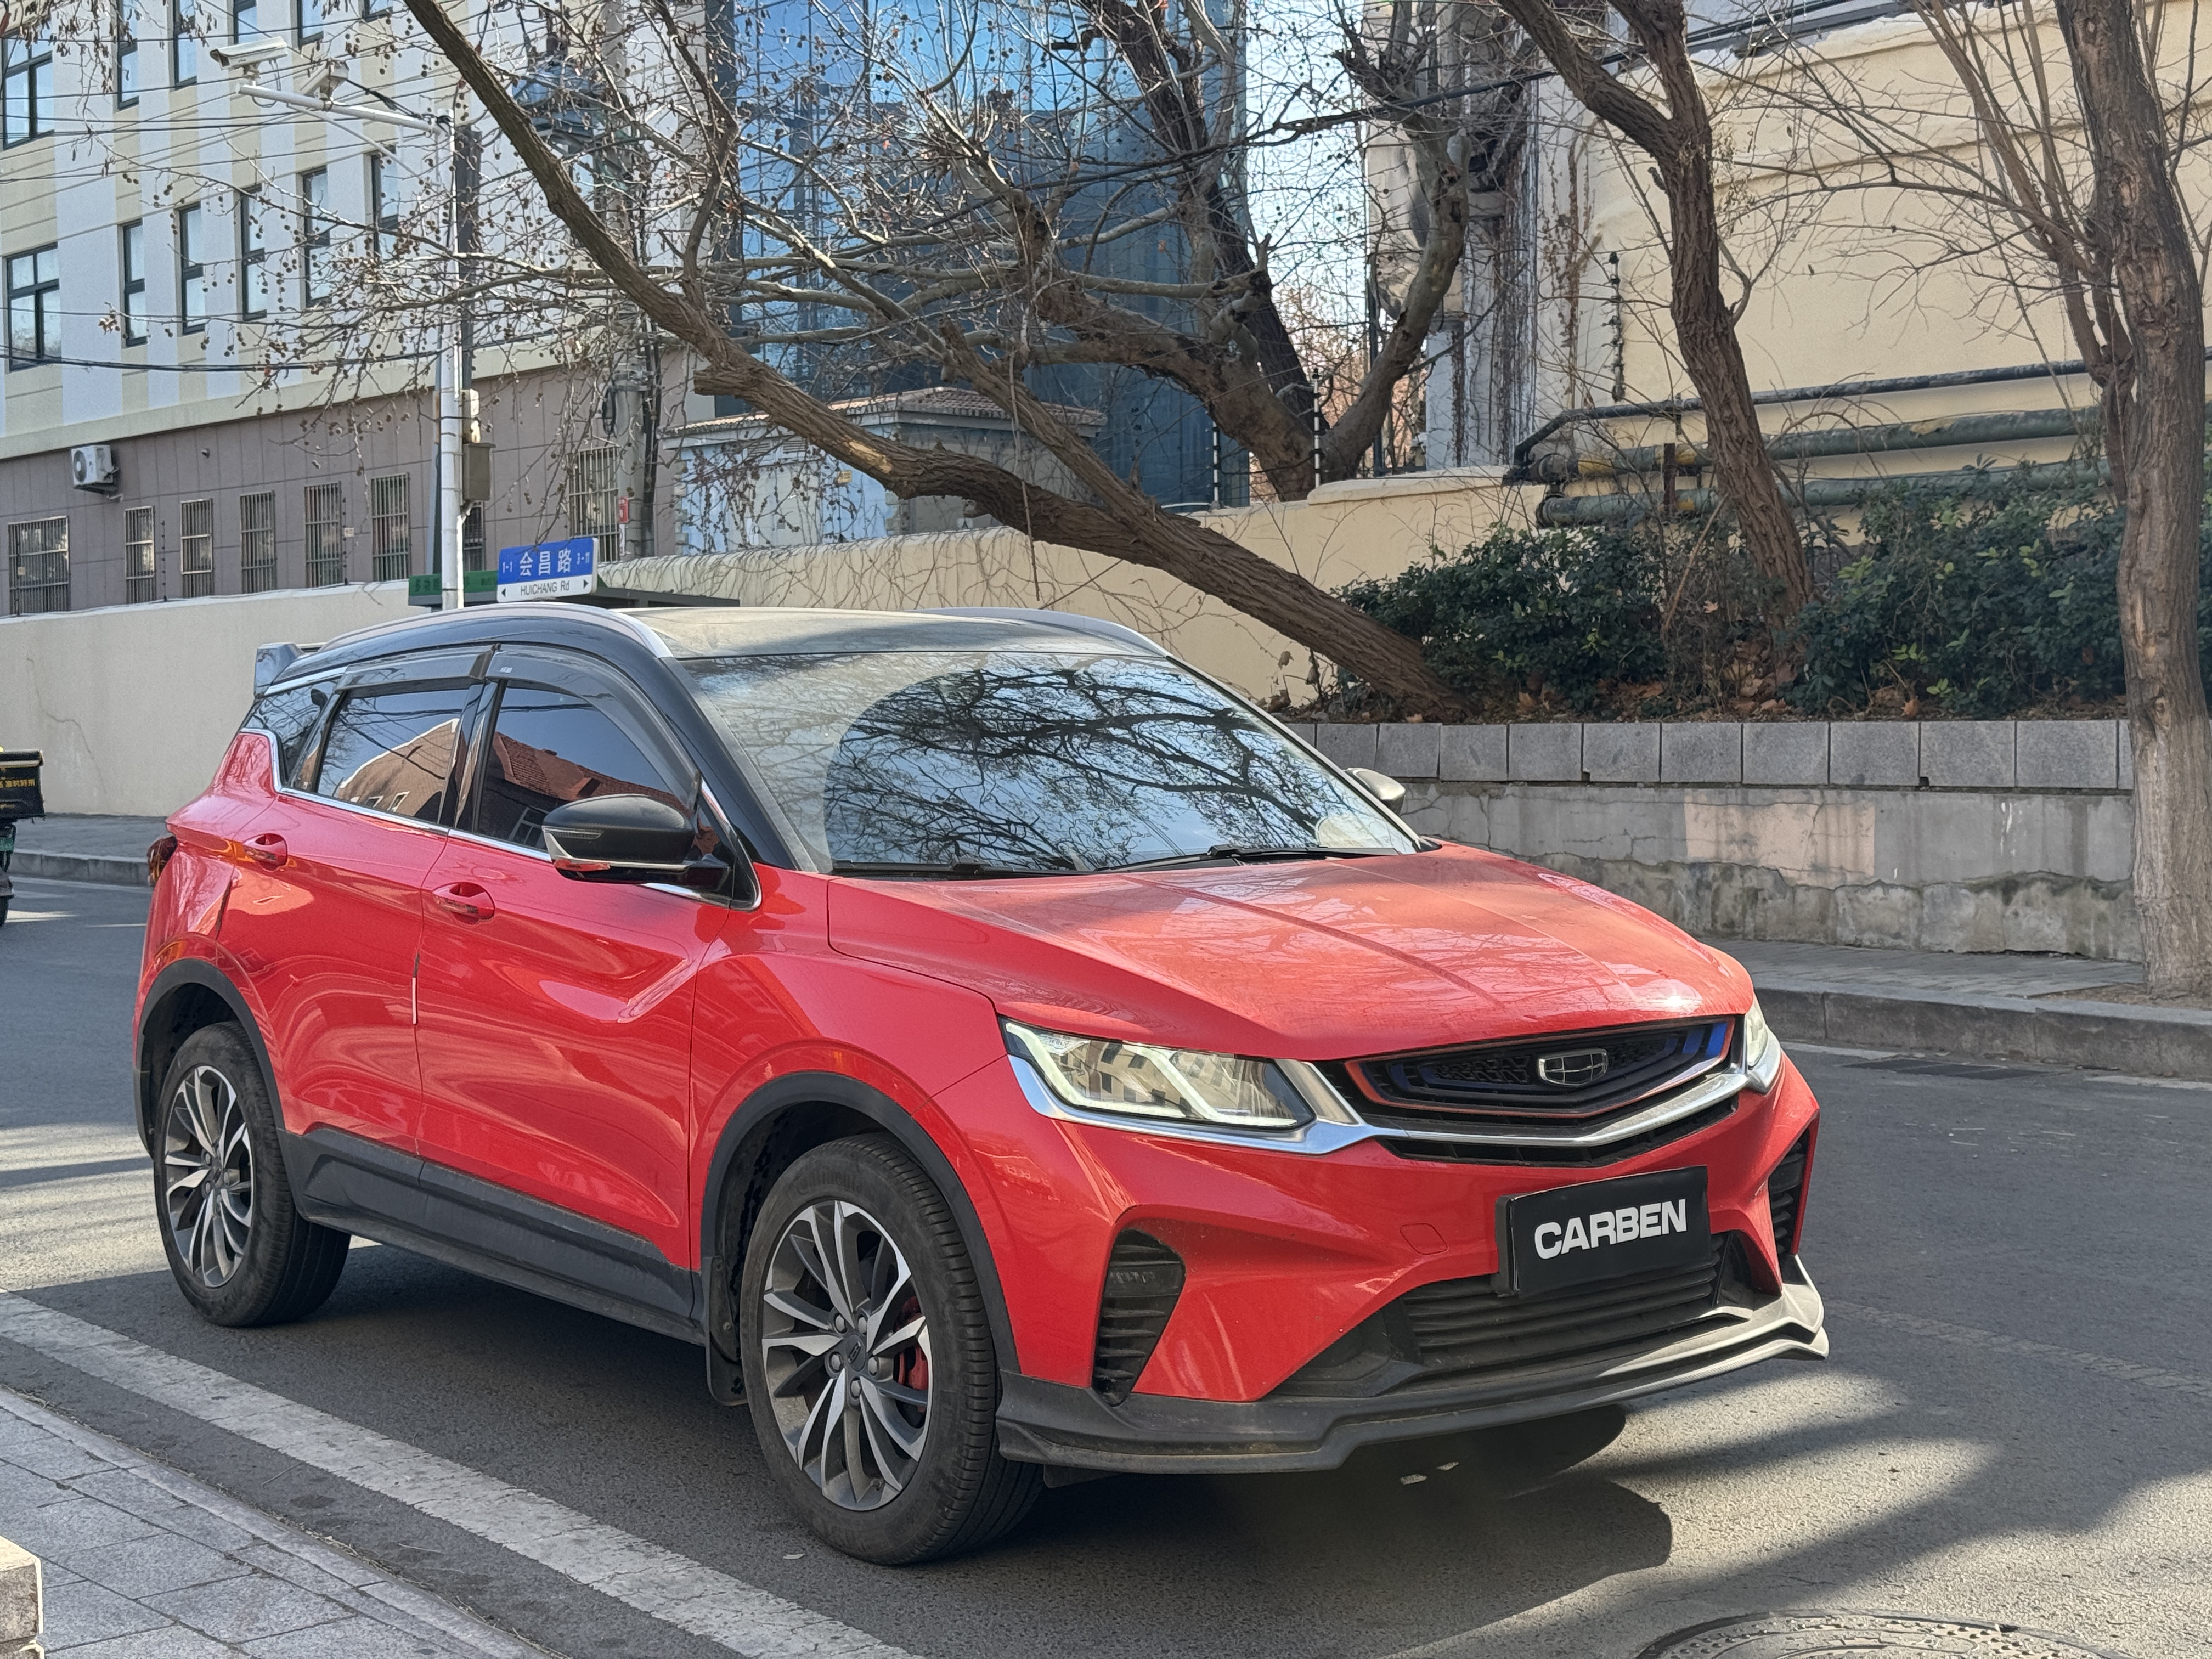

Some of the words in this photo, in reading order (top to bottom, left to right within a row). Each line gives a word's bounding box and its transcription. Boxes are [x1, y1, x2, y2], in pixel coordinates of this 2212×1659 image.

[520, 548, 572, 576] 会昌路
[521, 583, 557, 596] HUICHANG
[560, 580, 570, 591] Rd
[1534, 1199, 1687, 1259] CARBEN
